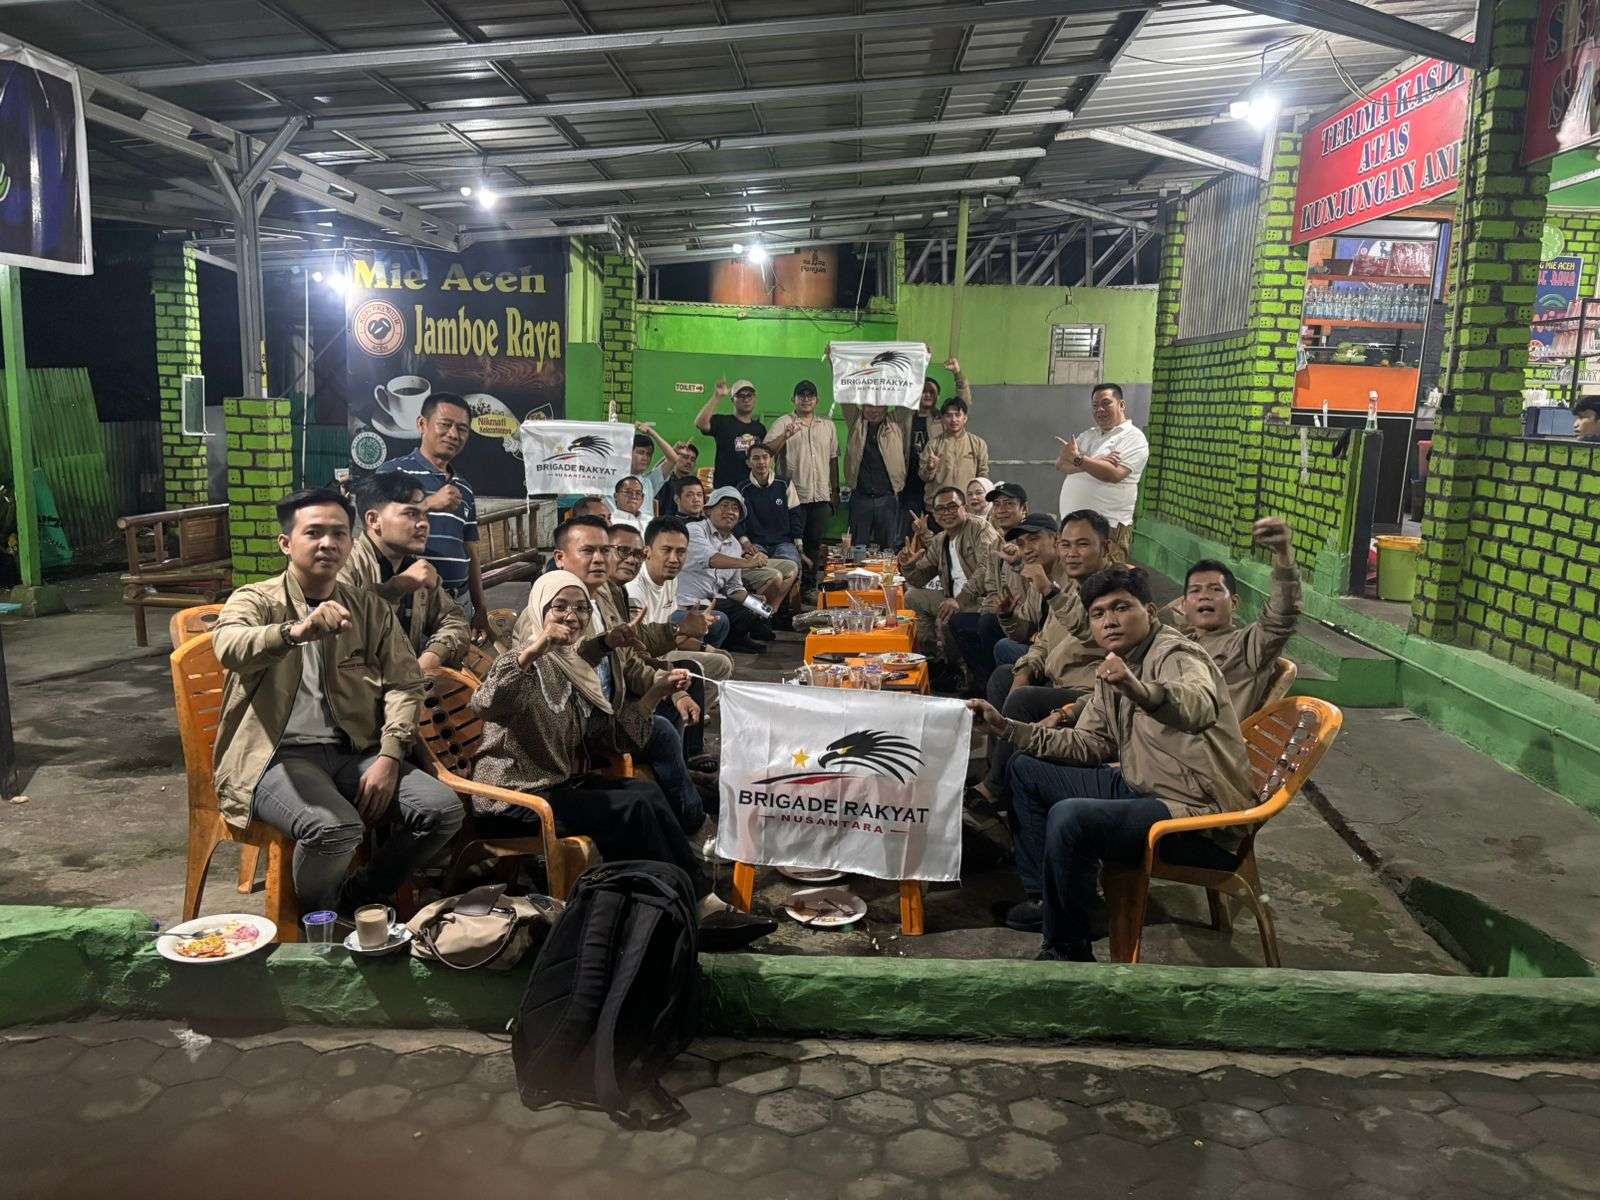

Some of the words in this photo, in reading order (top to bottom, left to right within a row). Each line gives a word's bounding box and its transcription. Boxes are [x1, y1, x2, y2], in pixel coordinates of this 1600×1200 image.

[1321, 92, 1390, 157] TERIMA
[1358, 121, 1410, 174] ATAS
[1300, 159, 1417, 232] KUNJUNGAN
[353, 259, 427, 290] Mie
[440, 263, 546, 293] Aceh
[414, 304, 499, 356] Jamboe
[505, 307, 561, 373] Raya
[841, 378, 880, 386] BRIGADE
[880, 379, 913, 388] RAKYAT
[536, 463, 577, 472] BRIGADE
[579, 465, 617, 476] RAKYAT
[738, 789, 837, 814] BRIGADE
[843, 801, 929, 824] RAKYAT
[780, 814, 884, 834] NUSANTARA
